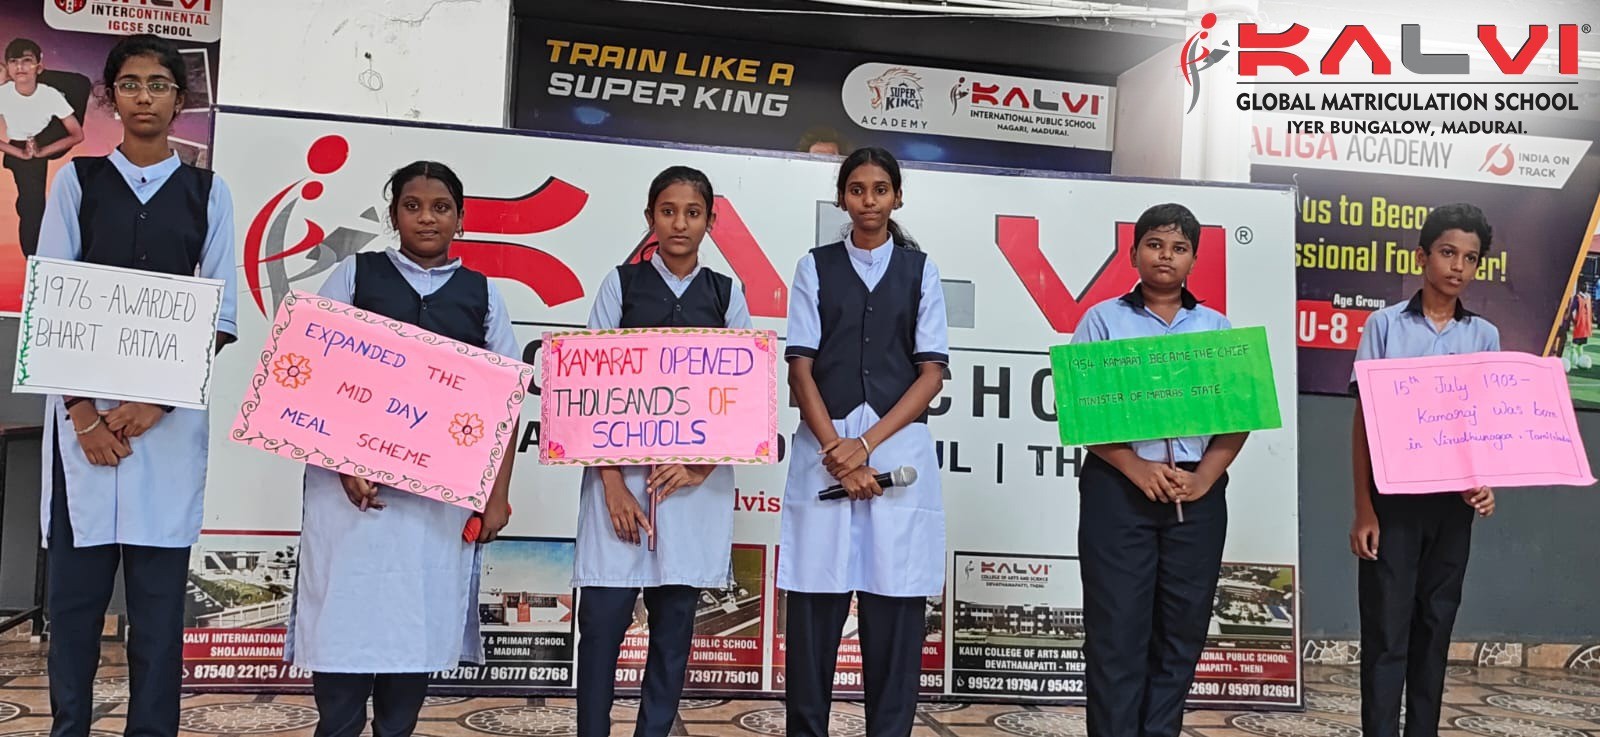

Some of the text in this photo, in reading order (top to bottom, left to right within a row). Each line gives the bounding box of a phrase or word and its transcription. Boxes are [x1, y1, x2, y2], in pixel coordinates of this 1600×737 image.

[91, 4, 210, 25] INTERCONTINENTAL
[108, 20, 192, 37] IGCSE SCHOOL
[546, 39, 795, 86] TRAIN LIKE A
[547, 72, 789, 117] SUPER KING
[890, 86, 917, 99] SUPER
[970, 81, 1100, 115] KALVI
[885, 97, 921, 110] KINGS
[861, 115, 929, 129] ACADEMY
[970, 109, 1096, 129] INTERNATIONAL PUBLIC SCHOOL
[997, 124, 1069, 136] NAGARI, MADURAI.
[1346, 134, 1453, 169] ACADEMY
[1518, 152, 1570, 166] INDIA ON
[1518, 166, 1556, 178] TRACK
[1302, 194, 1428, 230] us to Beco
[1333, 293, 1386, 309] Age Group
[35, 317, 103, 352] BHART
[305, 322, 467, 391] EXPANDED THE
[556, 346, 648, 377] KAMARAJ
[659, 346, 754, 376] OPENED
[1068, 344, 1249, 371] 1954 KAMARAJ BECAME THE CHIEF
[1434, 375, 1469, 400] July
[552, 386, 739, 417] THOUSANDS OF
[1078, 392, 1124, 406] MINISTER
[1130, 390, 1142, 402] OF
[1146, 388, 1184, 401] MADRAS
[337, 381, 428, 429] MID DAY
[280, 407, 431, 468] MEAL SCHEME
[592, 419, 707, 449] SCHOOLS
[1406, 436, 1423, 450] in
[981, 561, 1048, 575] KALVI
[183, 633, 287, 643] KALVI INTERNATIONA
[497, 637, 532, 646] PRIMARY
[534, 637, 566, 646] SCHOOL
[723, 639, 758, 649] SCHOOL
[210, 646, 283, 657] SHOLAVANDAN
[494, 647, 530, 656] MADURAI
[693, 651, 737, 662] DINDIGUL.
[959, 646, 982, 656] KALVI
[985, 647, 1022, 657] COLLEGE
[1024, 648, 1035, 658] OF
[1037, 649, 1059, 659] ARTS
[1060, 650, 1079, 659] AND
[1226, 652, 1255, 662] PUBLIC
[1257, 653, 1289, 663] SCHOOL
[194, 664, 235, 679] 87540
[985, 659, 1057, 671] DEVATHANAPATTI
[1195, 663, 1232, 673] ANAPATTI
[1240, 664, 1263, 673] THENI
[490, 666, 528, 680] 96777
[529, 666, 569, 681] 62768
[689, 669, 759, 684] 73977 75010
[967, 676, 1003, 690] 99522
[1006, 677, 1039, 691] 19794
[1047, 679, 1083, 692] 95432
[1228, 683, 1261, 696] 95970
[1262, 684, 1295, 698] 82691
